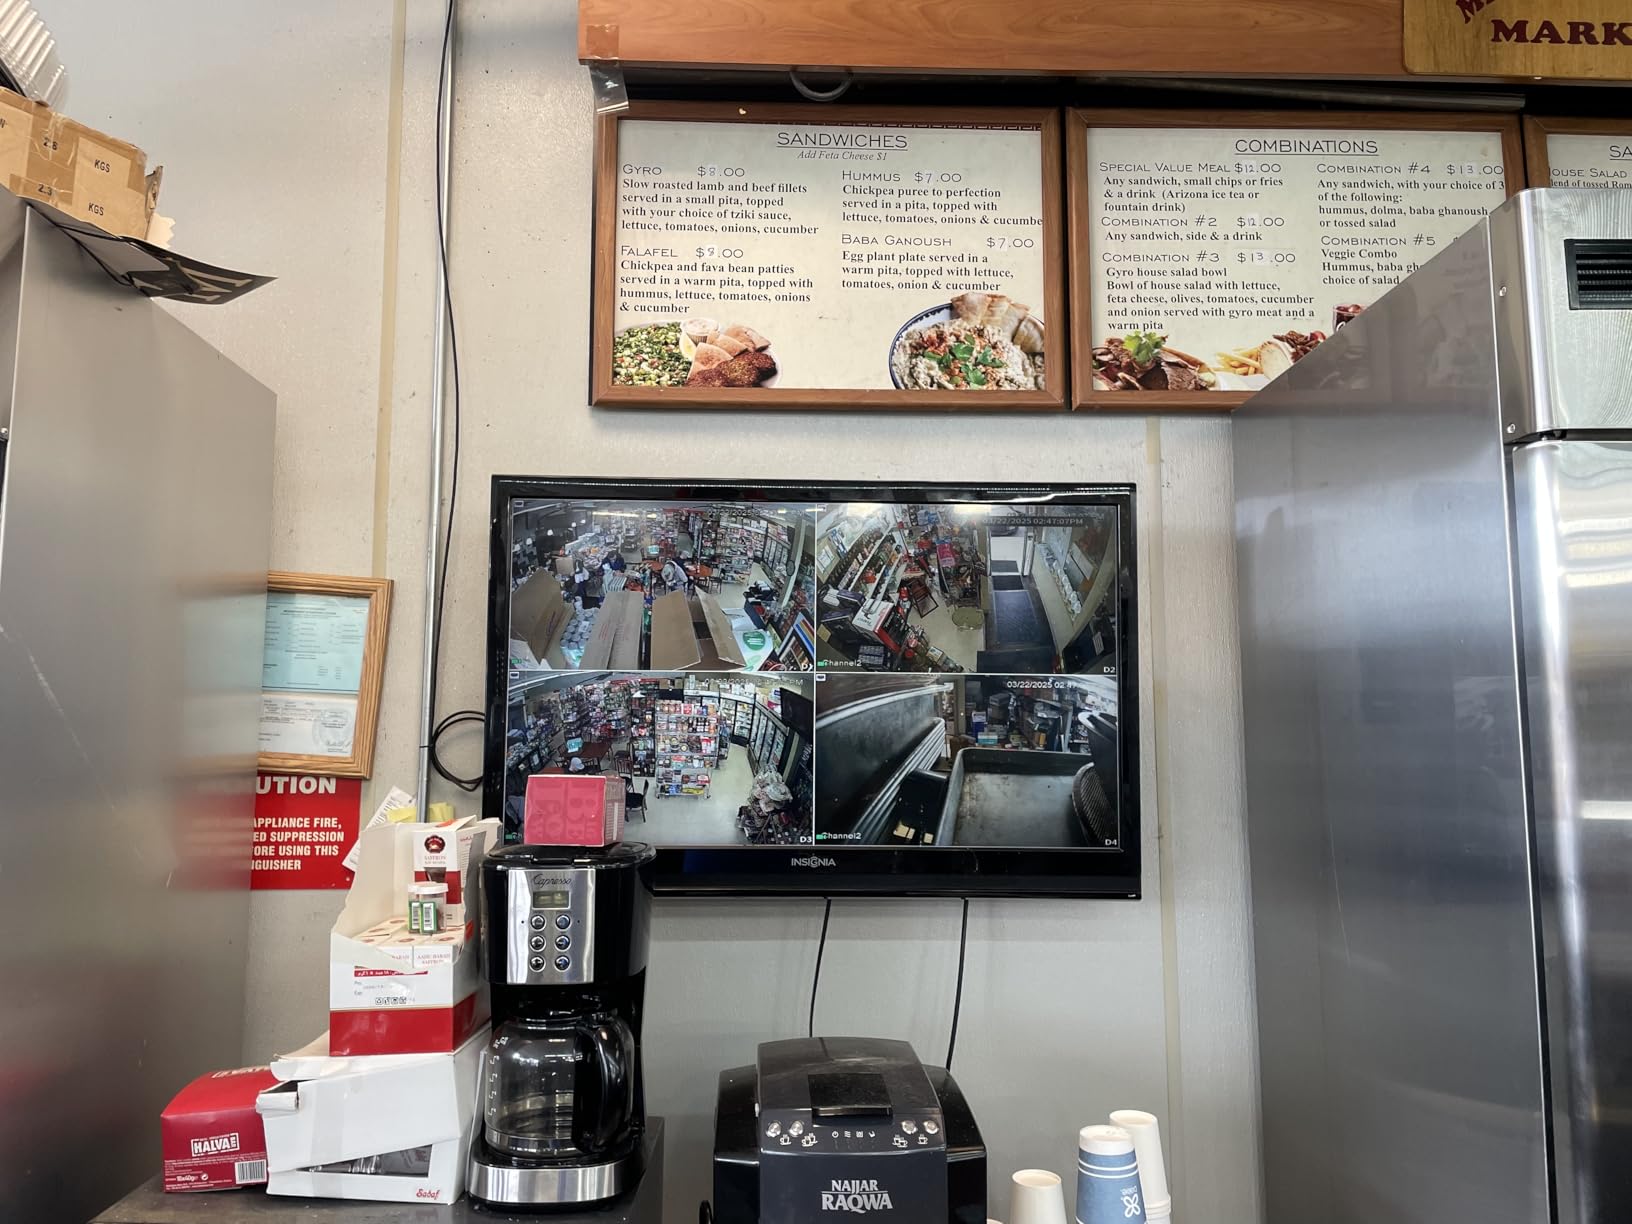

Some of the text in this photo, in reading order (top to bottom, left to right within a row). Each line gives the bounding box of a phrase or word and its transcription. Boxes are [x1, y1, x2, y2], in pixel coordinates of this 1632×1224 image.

[1491, 19, 1632, 46] MARK
[777, 132, 908, 149] SANDWICHES
[1235, 139, 1379, 154] COMBINATIONS
[797, 150, 816, 159] Add
[818, 150, 839, 160] Feta
[841, 151, 874, 160] Cheese
[94, 159, 111, 173] KGS
[1590, 168, 1627, 178] SALAD
[622, 179, 807, 192] Slow roasted lamb and beef fillets
[1103, 175, 1124, 188] Any
[1128, 175, 1180, 187] sandwich,
[1183, 175, 1212, 185] small
[1214, 175, 1242, 188] chips
[1260, 175, 1283, 186] fries
[1317, 178, 1505, 192] Any sandwich, with your choice of 3
[842, 184, 1000, 200] Chickpea puree to perfection
[1318, 191, 1402, 204] of the following:
[88, 202, 104, 216] KGS
[622, 206, 791, 221] with your choice of tziki sauce,
[1104, 201, 1185, 214] fountain drink)
[1318, 204, 1367, 216] hummus,
[1370, 204, 1406, 217] dolma,
[1409, 205, 1434, 215] baba
[842, 212, 881, 224] lettuce,
[885, 213, 937, 225] tomatoes,
[940, 214, 976, 224] onions
[979, 214, 989, 224] &
[622, 220, 818, 234] lettuce, tomatoes, onions, cucumber
[1321, 248, 1397, 261] Veggie Combo
[620, 260, 794, 276] Chickpea and fava bean patties
[1106, 266, 1226, 279] Gyro house salad bowl
[1322, 261, 1374, 274] Hummus,
[1376, 262, 1402, 272] baba
[842, 278, 1000, 290] tomatoes, onion & cucumber
[1106, 280, 1280, 292] Bowl of house salad with lettuce,
[620, 288, 810, 303] hummus, lettuce, tomatoes, onions
[1107, 293, 1314, 305] feta cheese, olives, tomatoes, cucumber
[619, 301, 690, 313] & cucumber
[1142, 320, 1163, 333] pita
[1007, 681, 1052, 689] 03/22/2025
[313, 818, 342, 830] FIRE,
[270, 831, 345, 842] SUPPRESSION
[279, 845, 311, 856] USING
[315, 845, 339, 856] THIS
[791, 856, 836, 868] INSIGNIA
[193, 1138, 231, 1154] HALVA
[831, 1179, 879, 1194] NAJJAR
[821, 1193, 893, 1214] RAQWA
